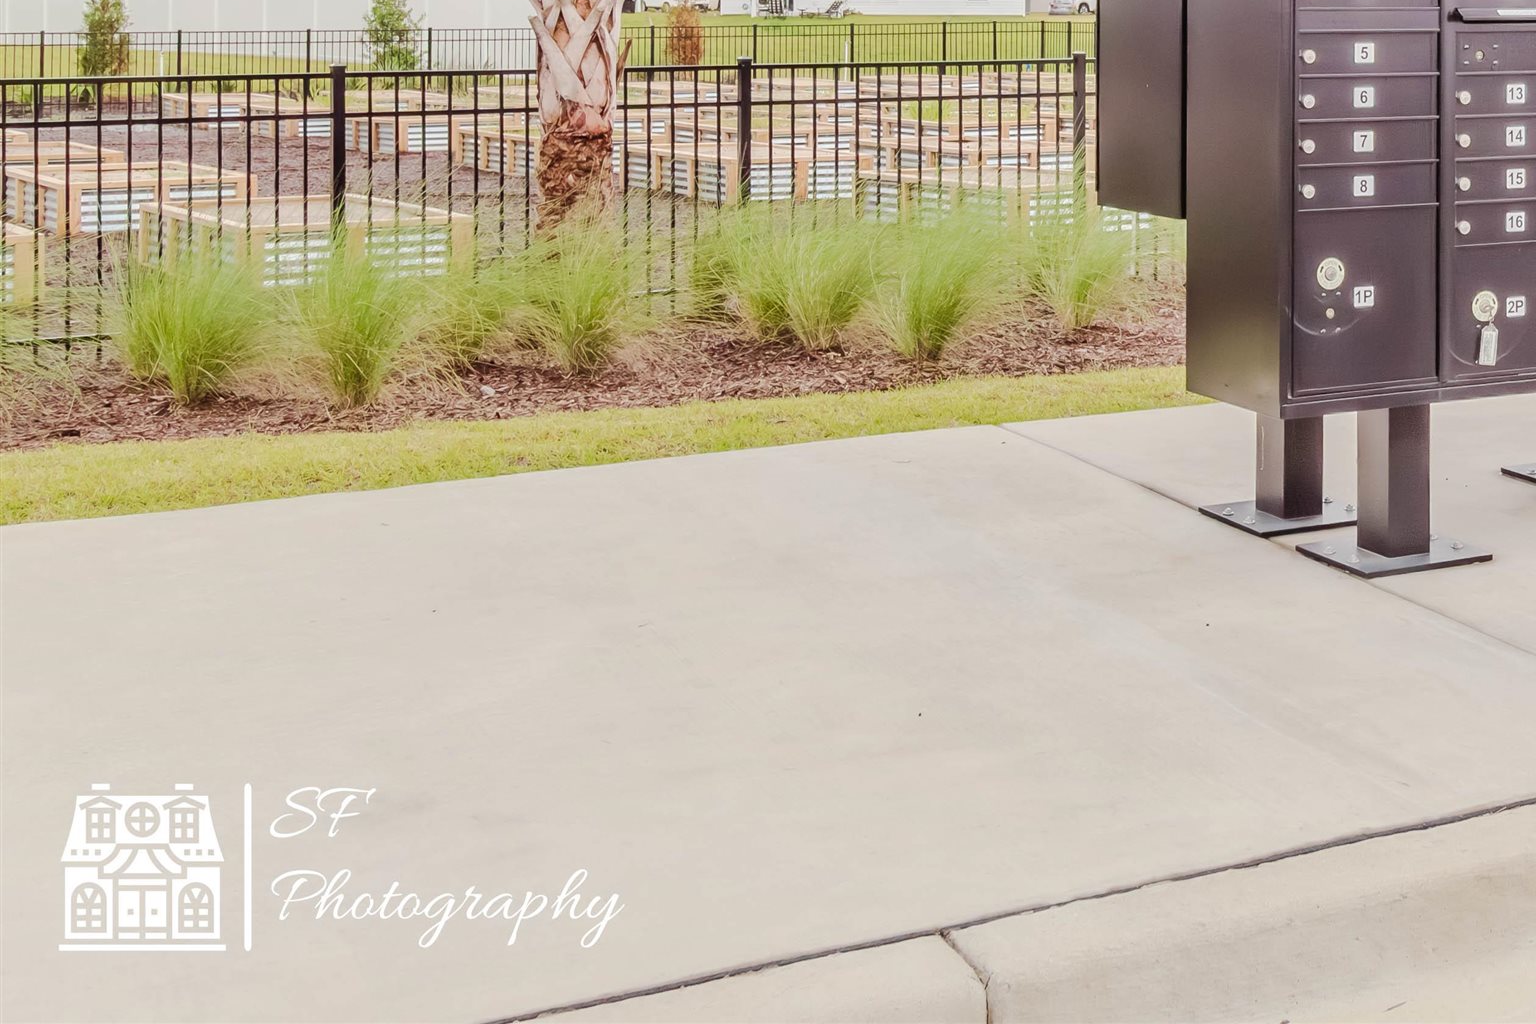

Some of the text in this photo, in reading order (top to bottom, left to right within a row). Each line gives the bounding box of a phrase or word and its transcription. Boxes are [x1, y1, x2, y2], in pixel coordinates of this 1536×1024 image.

[1360, 46, 1369, 60] 5
[1359, 90, 1368, 104] 6
[1508, 86, 1524, 101] 13
[1359, 134, 1368, 148] 7
[1508, 129, 1523, 143] 14
[1508, 171, 1524, 186] 15
[1359, 179, 1368, 193] 8
[1508, 215, 1523, 229] 16
[1355, 289, 1372, 304] 1P
[1508, 299, 1524, 314] 2P
